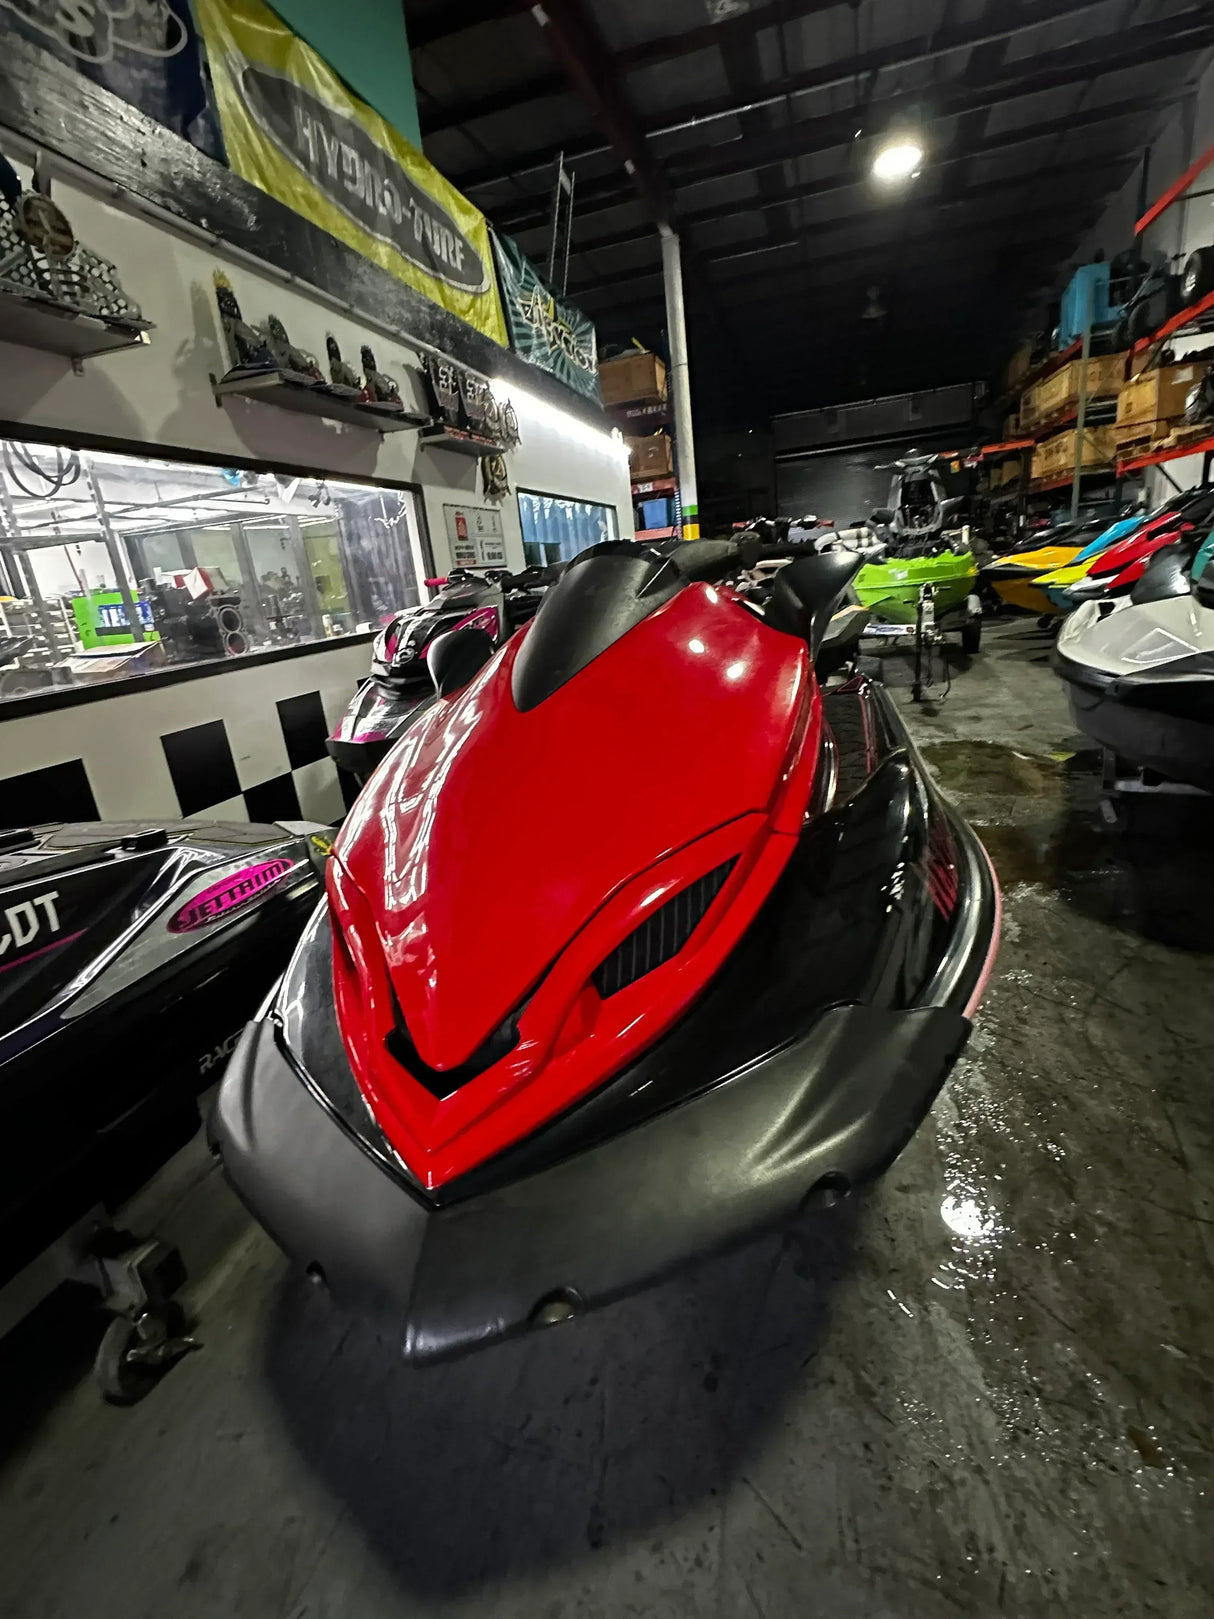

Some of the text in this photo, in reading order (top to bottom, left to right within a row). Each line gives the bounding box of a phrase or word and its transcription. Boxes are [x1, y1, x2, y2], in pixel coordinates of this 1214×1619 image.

[294, 105, 465, 272] HYDRO-TURF
[0, 890, 60, 956] DT
[178, 861, 285, 923] JETTRIM
[199, 1027, 245, 1074] RAC
